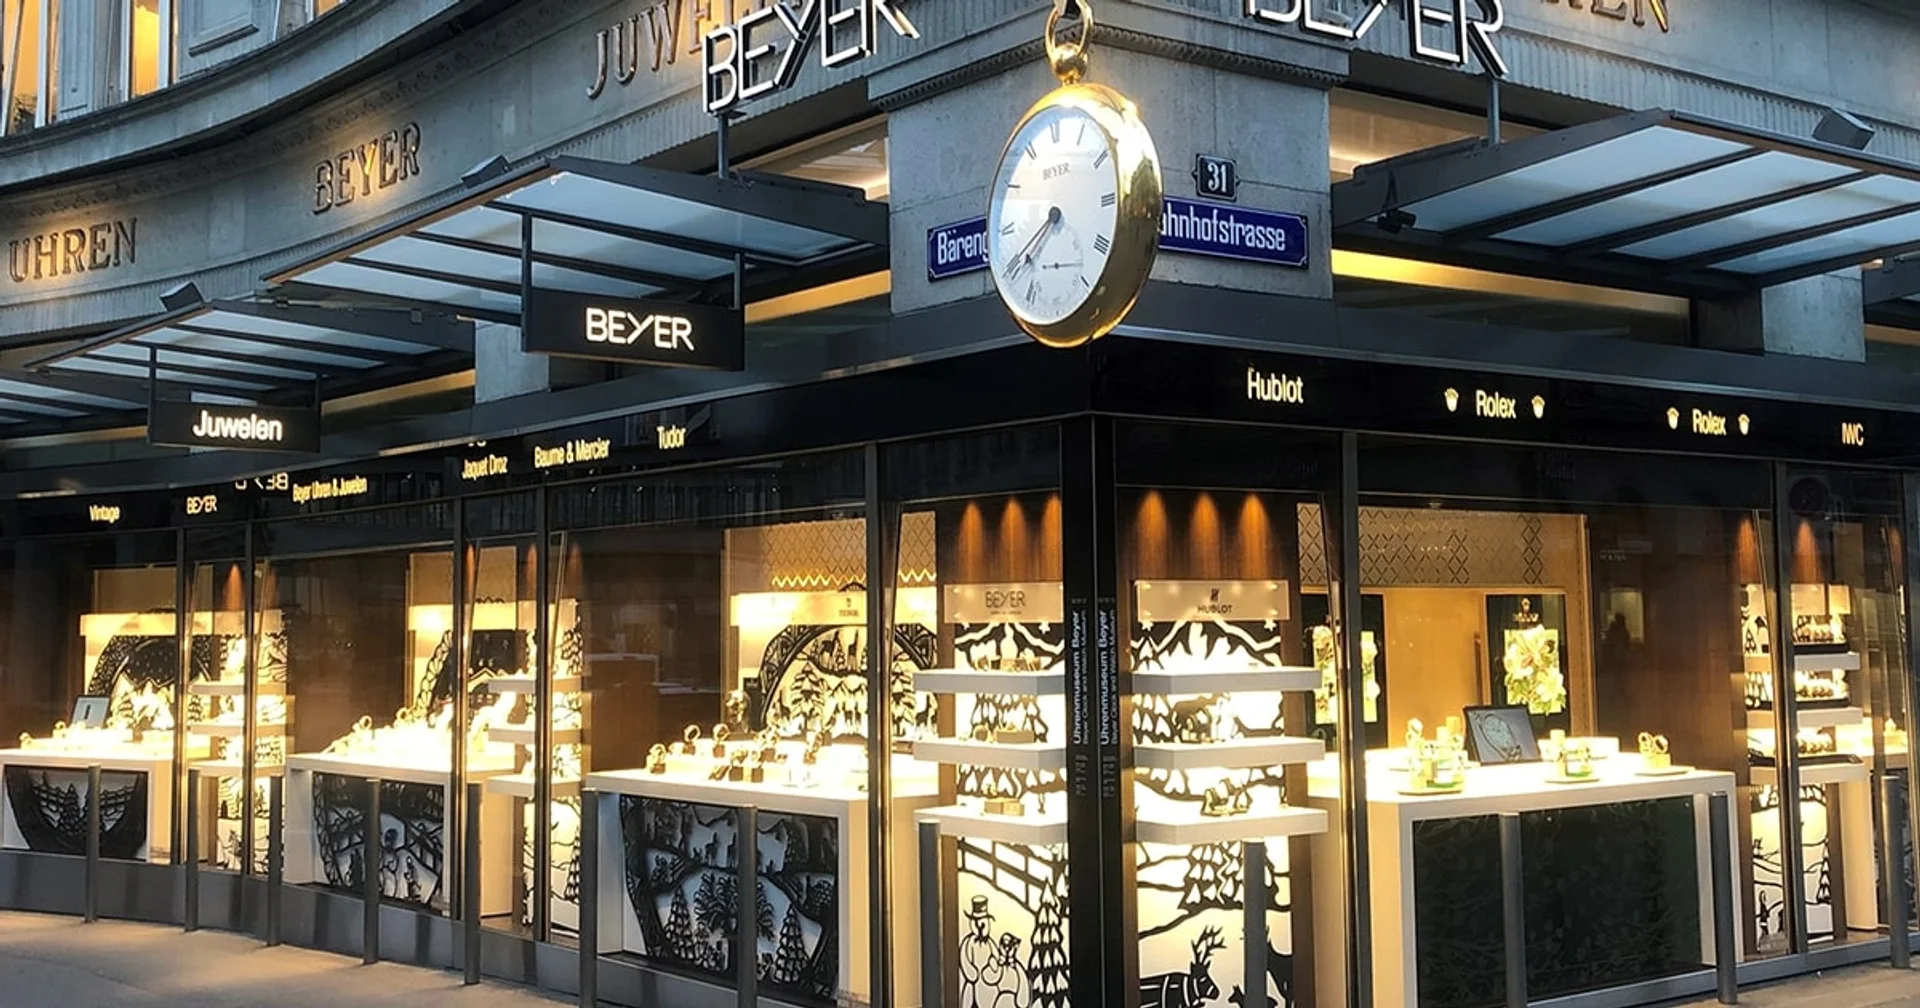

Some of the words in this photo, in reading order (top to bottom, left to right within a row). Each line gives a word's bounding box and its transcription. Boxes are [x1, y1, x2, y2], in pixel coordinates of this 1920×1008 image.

[312, 121, 422, 216] BEYER
[1043, 163, 1071, 180] BEYER
[1207, 162, 1227, 192] 31
[9, 217, 138, 283] UHREN
[585, 307, 695, 351] BEYER
[1247, 368, 1304, 403] Hublot
[1475, 389, 1517, 419] Rolex
[192, 409, 283, 442] Juwelen
[656, 425, 687, 449] Tudor
[1692, 408, 1727, 436] Rolex
[1841, 422, 1864, 447] IWC
[534, 445, 565, 468] Baume
[566, 440, 575, 463] &
[575, 437, 611, 462] Mercier
[89, 504, 120, 524] Vintage
[186, 495, 218, 515] BEYER
[985, 591, 1026, 608] BEYER
[1197, 604, 1232, 614] HUBLOT
[1071, 610, 1081, 648] Beyer
[1098, 610, 1109, 648] Beyer
[1073, 652, 1082, 745] Uhrenmuseum
[1100, 652, 1110, 745] Uhrenmuseum
